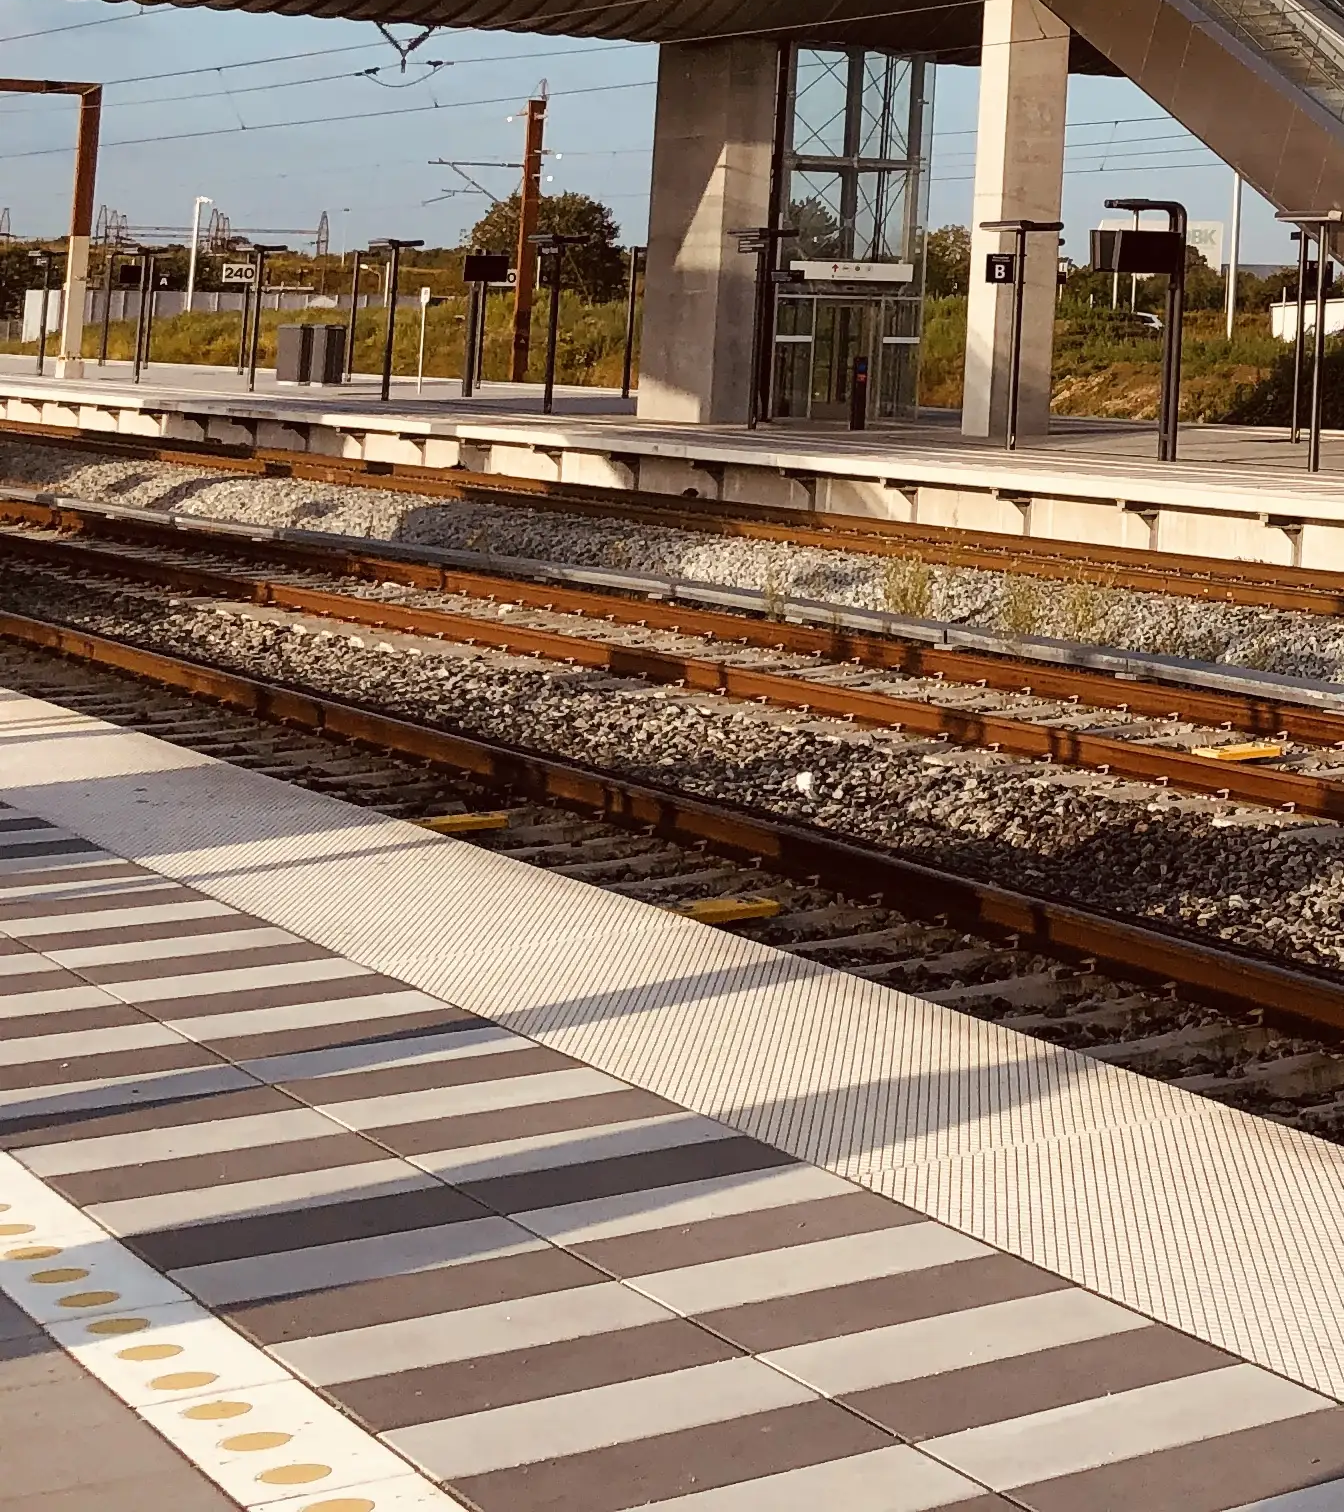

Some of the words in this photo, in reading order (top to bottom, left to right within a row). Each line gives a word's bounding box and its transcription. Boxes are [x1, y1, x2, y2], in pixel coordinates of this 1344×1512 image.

[225, 267, 255, 280] 240
[994, 264, 1006, 279] B
[159, 277, 168, 287] A
